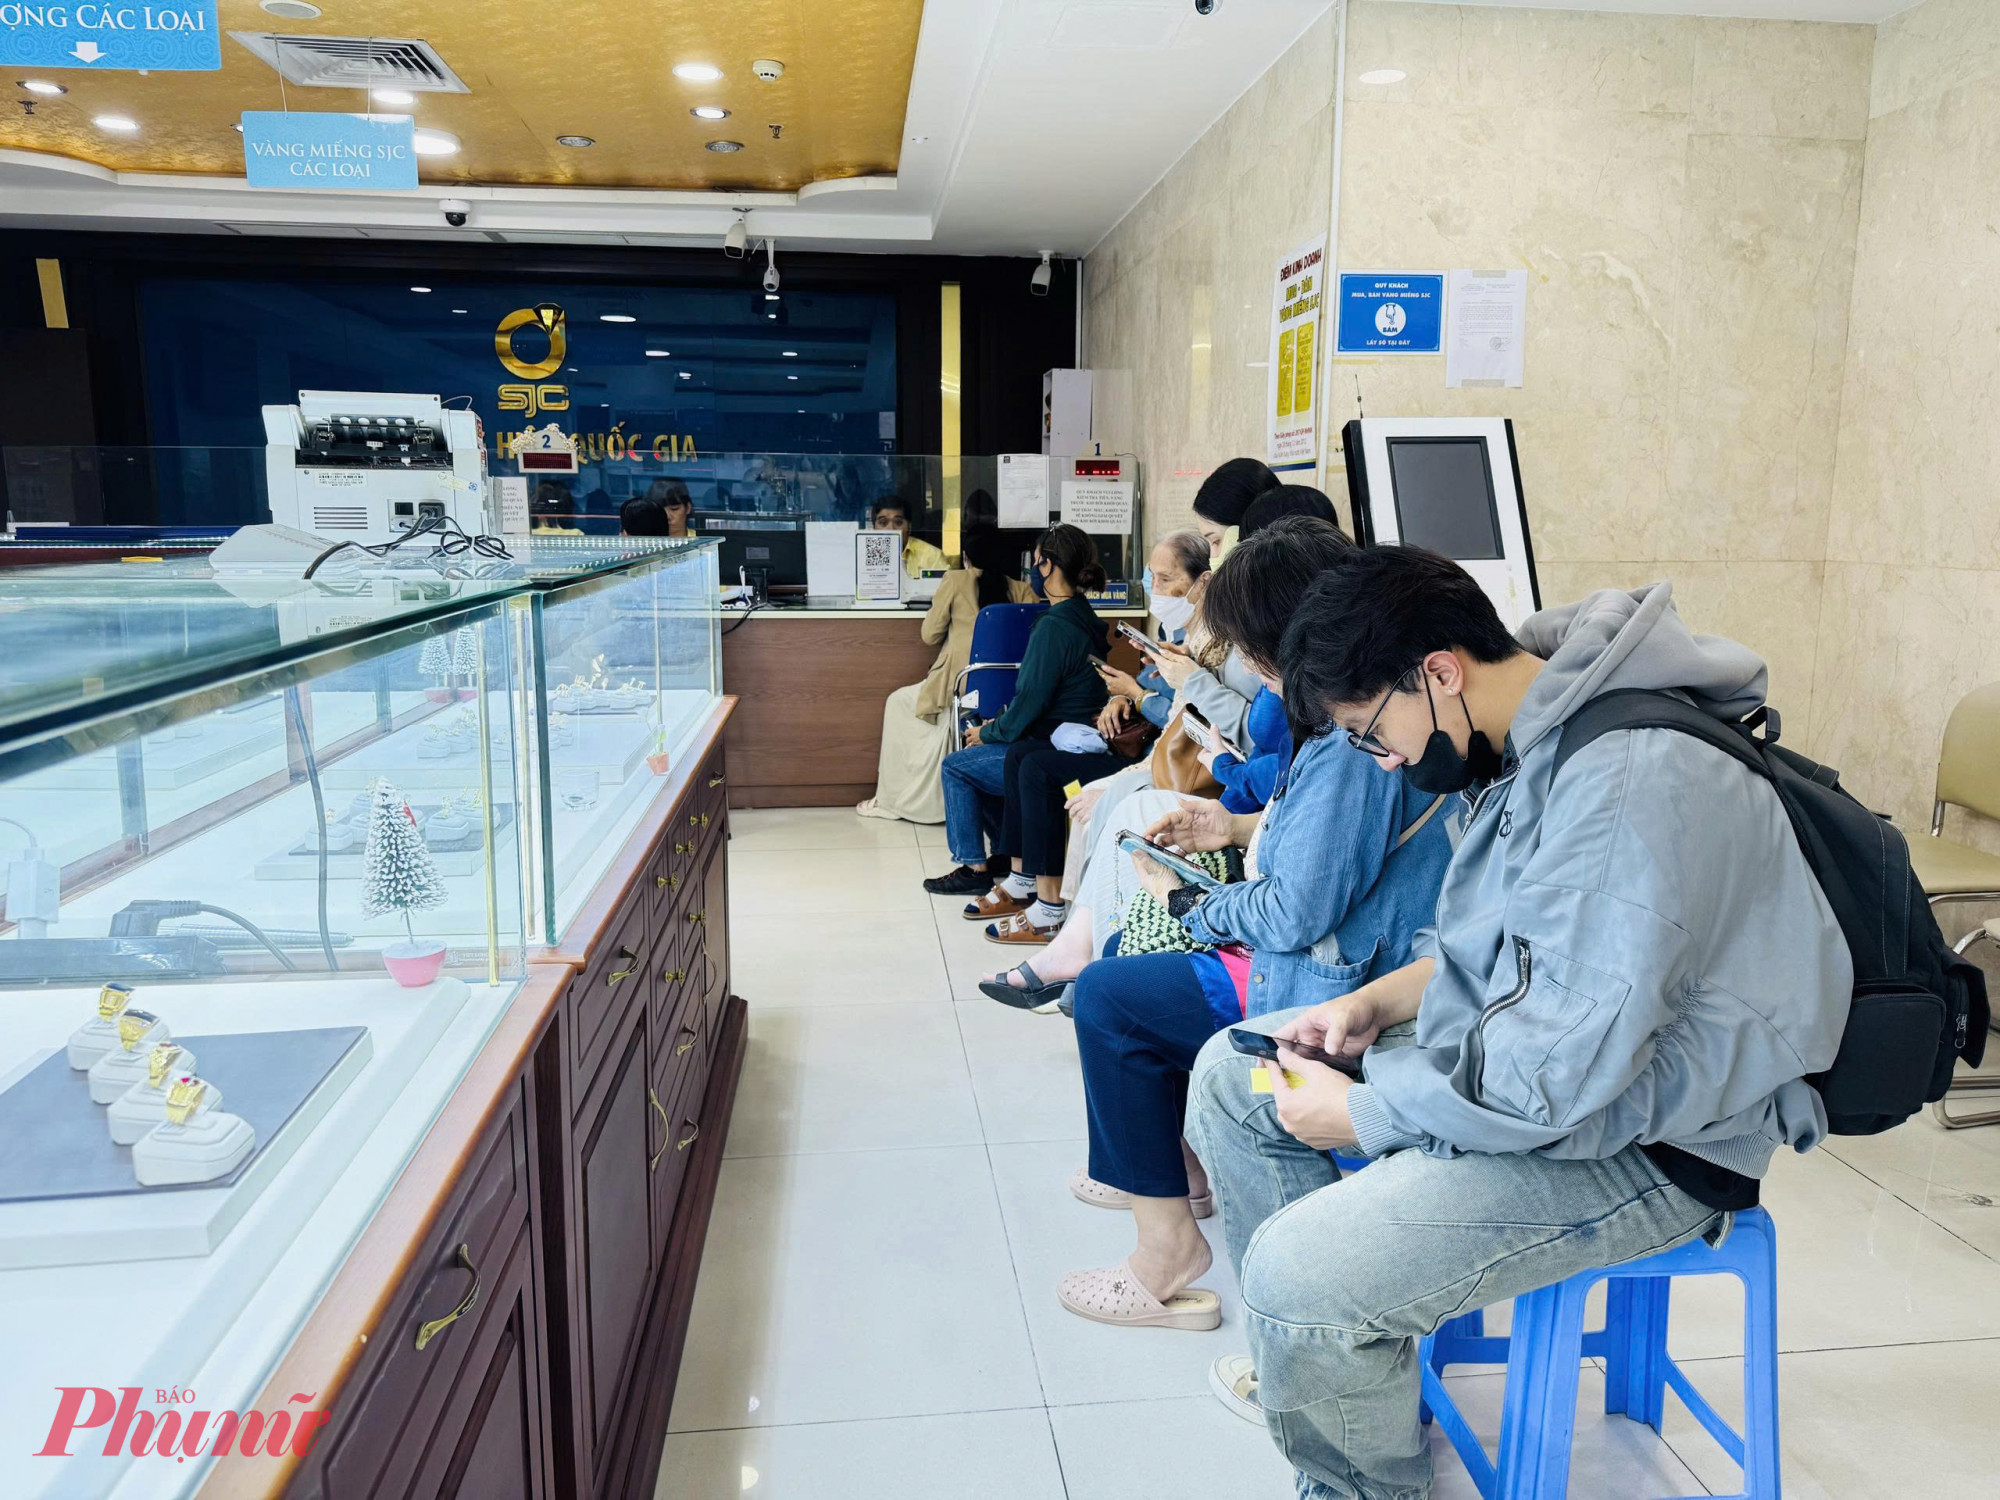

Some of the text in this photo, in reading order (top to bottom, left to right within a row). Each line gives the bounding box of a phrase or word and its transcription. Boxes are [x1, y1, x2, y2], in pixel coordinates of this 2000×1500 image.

[75, 2, 136, 30] CÁC
[144, 6, 207, 36] LOẠI
[251, 139, 406, 163] VÀNG MIẾNG SJC
[289, 159, 371, 180] CÁC LOẠI
[1303, 247, 1322, 270] DOANH
[1388, 281, 1409, 289] KHÁCH
[497, 384, 570, 419] SJC
[542, 434, 551, 449] 2
[573, 421, 643, 465] QUỐC
[653, 434, 698, 463] GIA
[1094, 443, 1101, 456] 1
